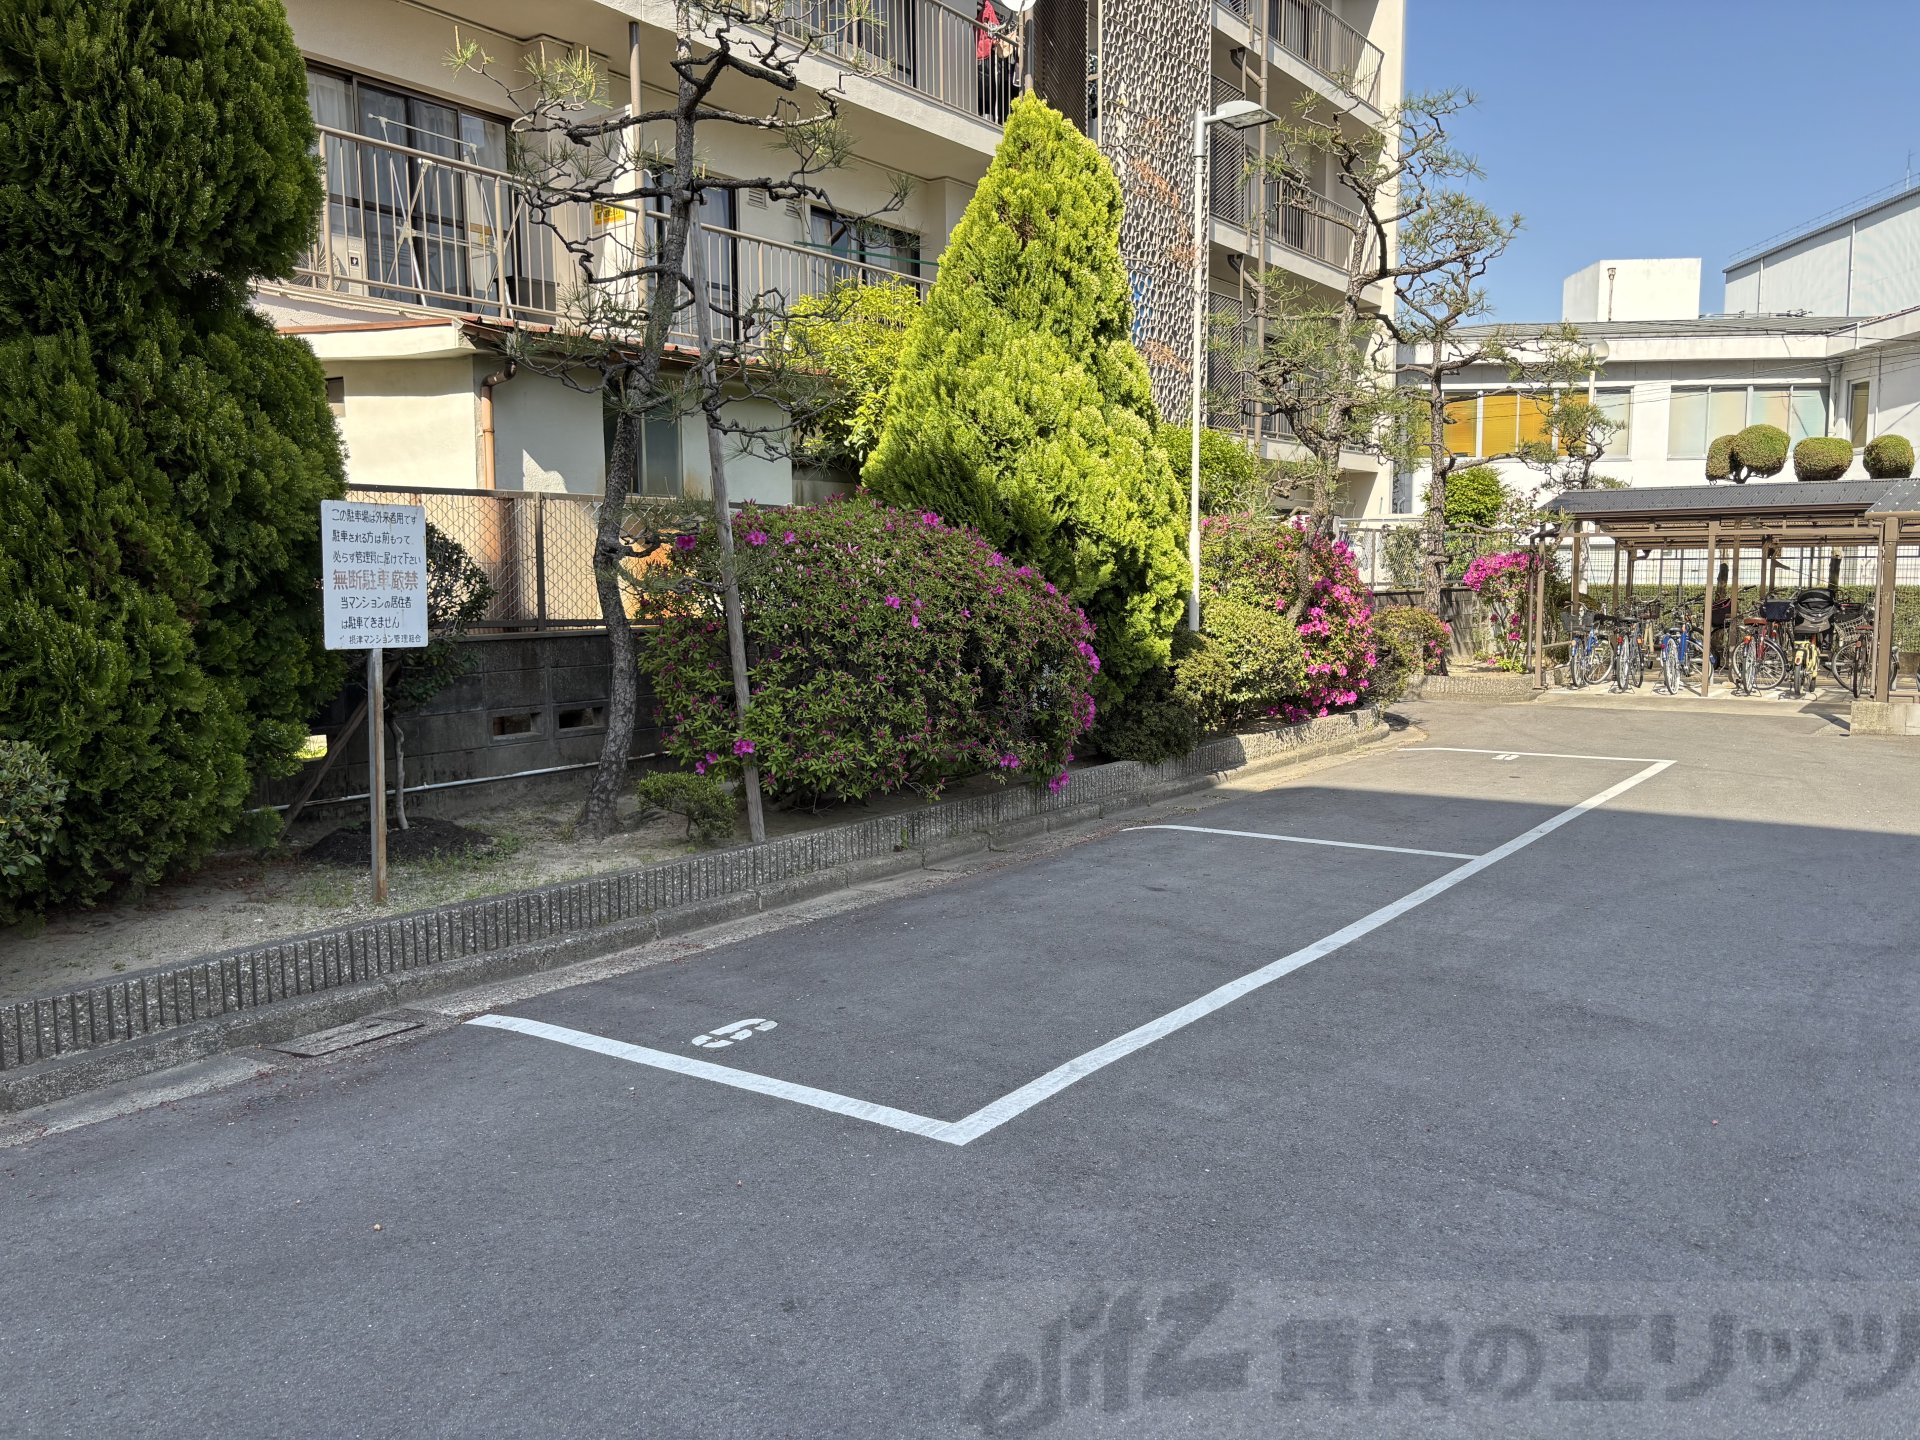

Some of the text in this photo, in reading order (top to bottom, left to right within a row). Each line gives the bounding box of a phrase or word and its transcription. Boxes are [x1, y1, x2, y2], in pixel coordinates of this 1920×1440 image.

[332, 508, 416, 525] この駐車場は外来者用です
[333, 550, 421, 565] 必らず管理員に届けて下さい
[333, 569, 418, 590] 無断駐車厳禁
[341, 595, 412, 609] 当マンションの居住者
[341, 616, 400, 629] は駐車できません
